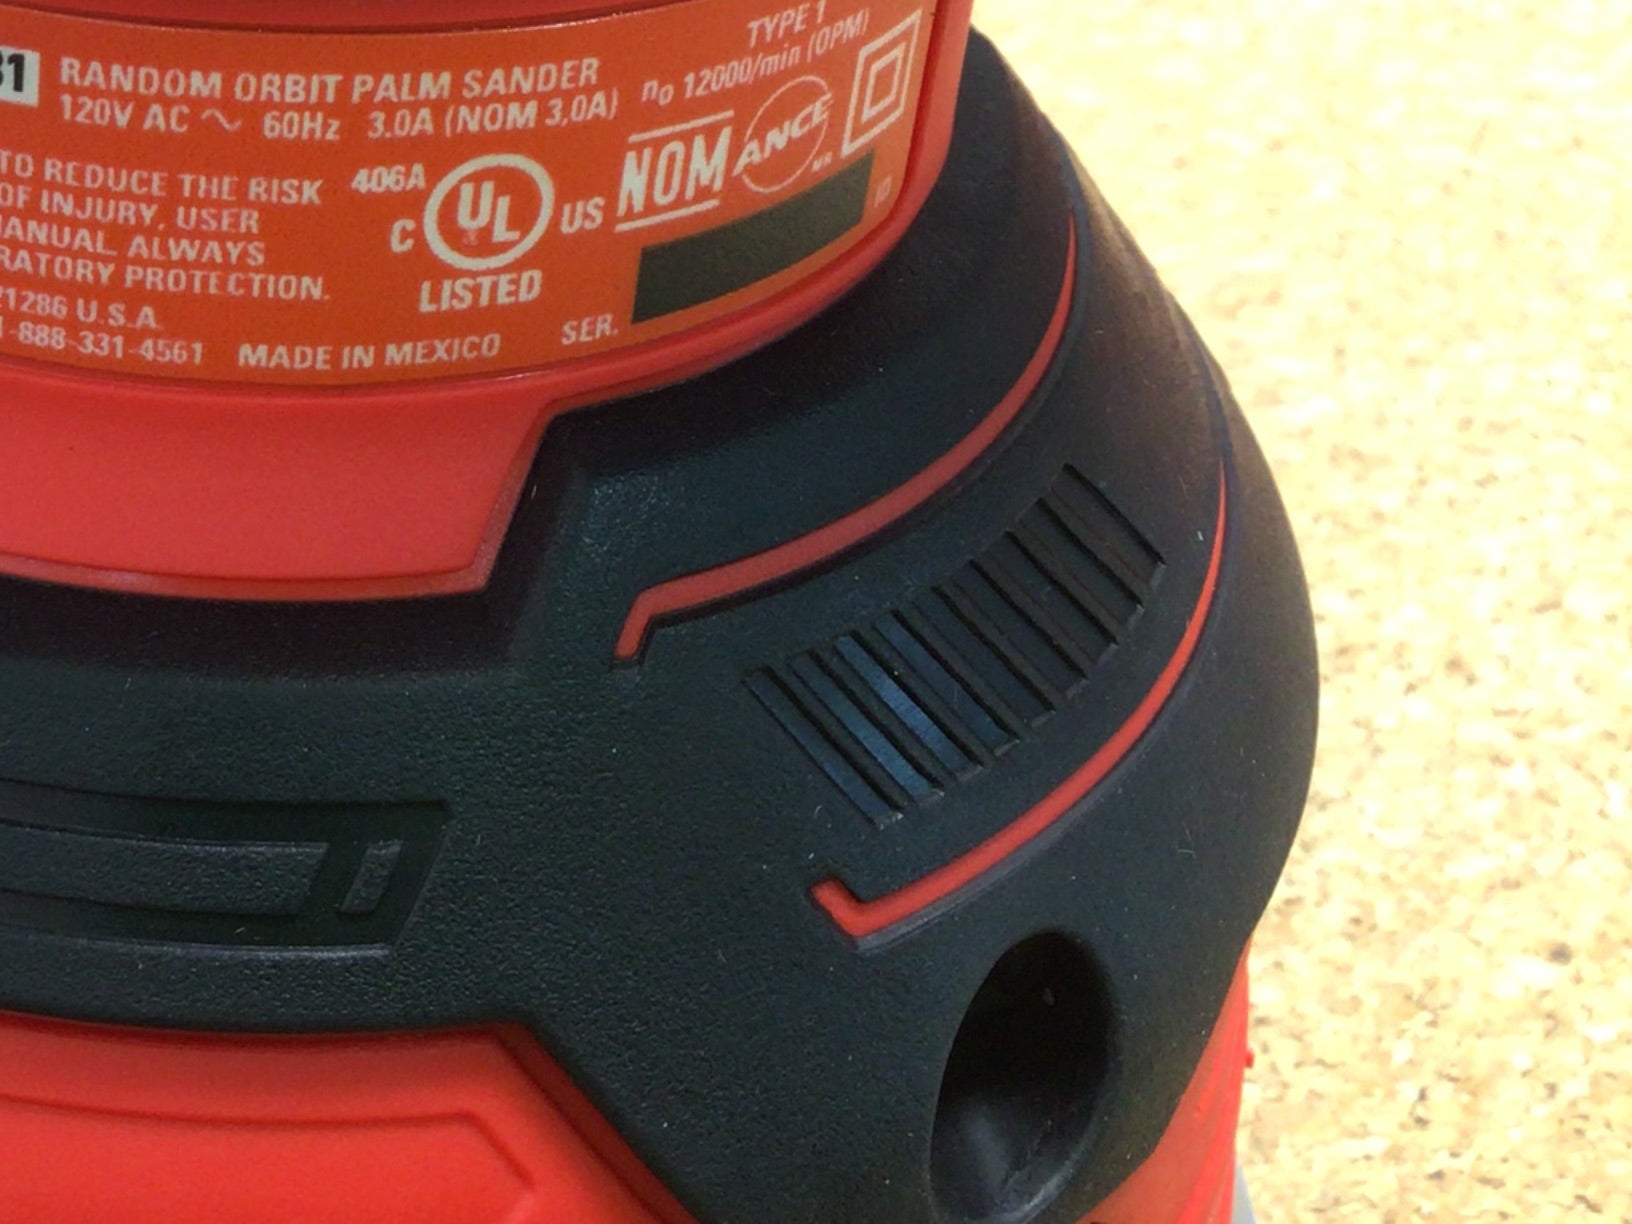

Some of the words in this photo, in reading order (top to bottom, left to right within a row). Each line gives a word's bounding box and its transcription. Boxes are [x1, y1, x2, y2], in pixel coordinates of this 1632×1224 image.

[747, 3, 810, 48] TYPE
[684, 43, 802, 100] 12000/min
[807, 8, 869, 62] (OPM)
[60, 56, 222, 99] RANDOM
[234, 72, 343, 103] ORBIT
[352, 71, 452, 104] PALM
[463, 57, 599, 98] SANDER
[61, 94, 135, 128] 120V
[143, 104, 191, 134] AC
[263, 111, 341, 141] 60Hz
[368, 107, 434, 139] 3.0A
[445, 100, 538, 137] (NOM
[732, 93, 834, 177] ANCE
[44, 159, 167, 197] REDUCE
[180, 174, 236, 201] THE
[248, 177, 323, 205] RISK
[350, 163, 426, 194] 406A
[616, 126, 732, 216] NOM
[176, 207, 259, 234] USER
[457, 181, 520, 243] UL
[560, 197, 605, 233] US
[127, 236, 266, 267] ALWAYS
[125, 265, 330, 301] PROTECTION.
[419, 270, 542, 312] LISTED
[238, 343, 331, 370] MADE
[342, 344, 373, 368] IN
[384, 333, 500, 366] MEXICO
[561, 313, 619, 346] SER.
